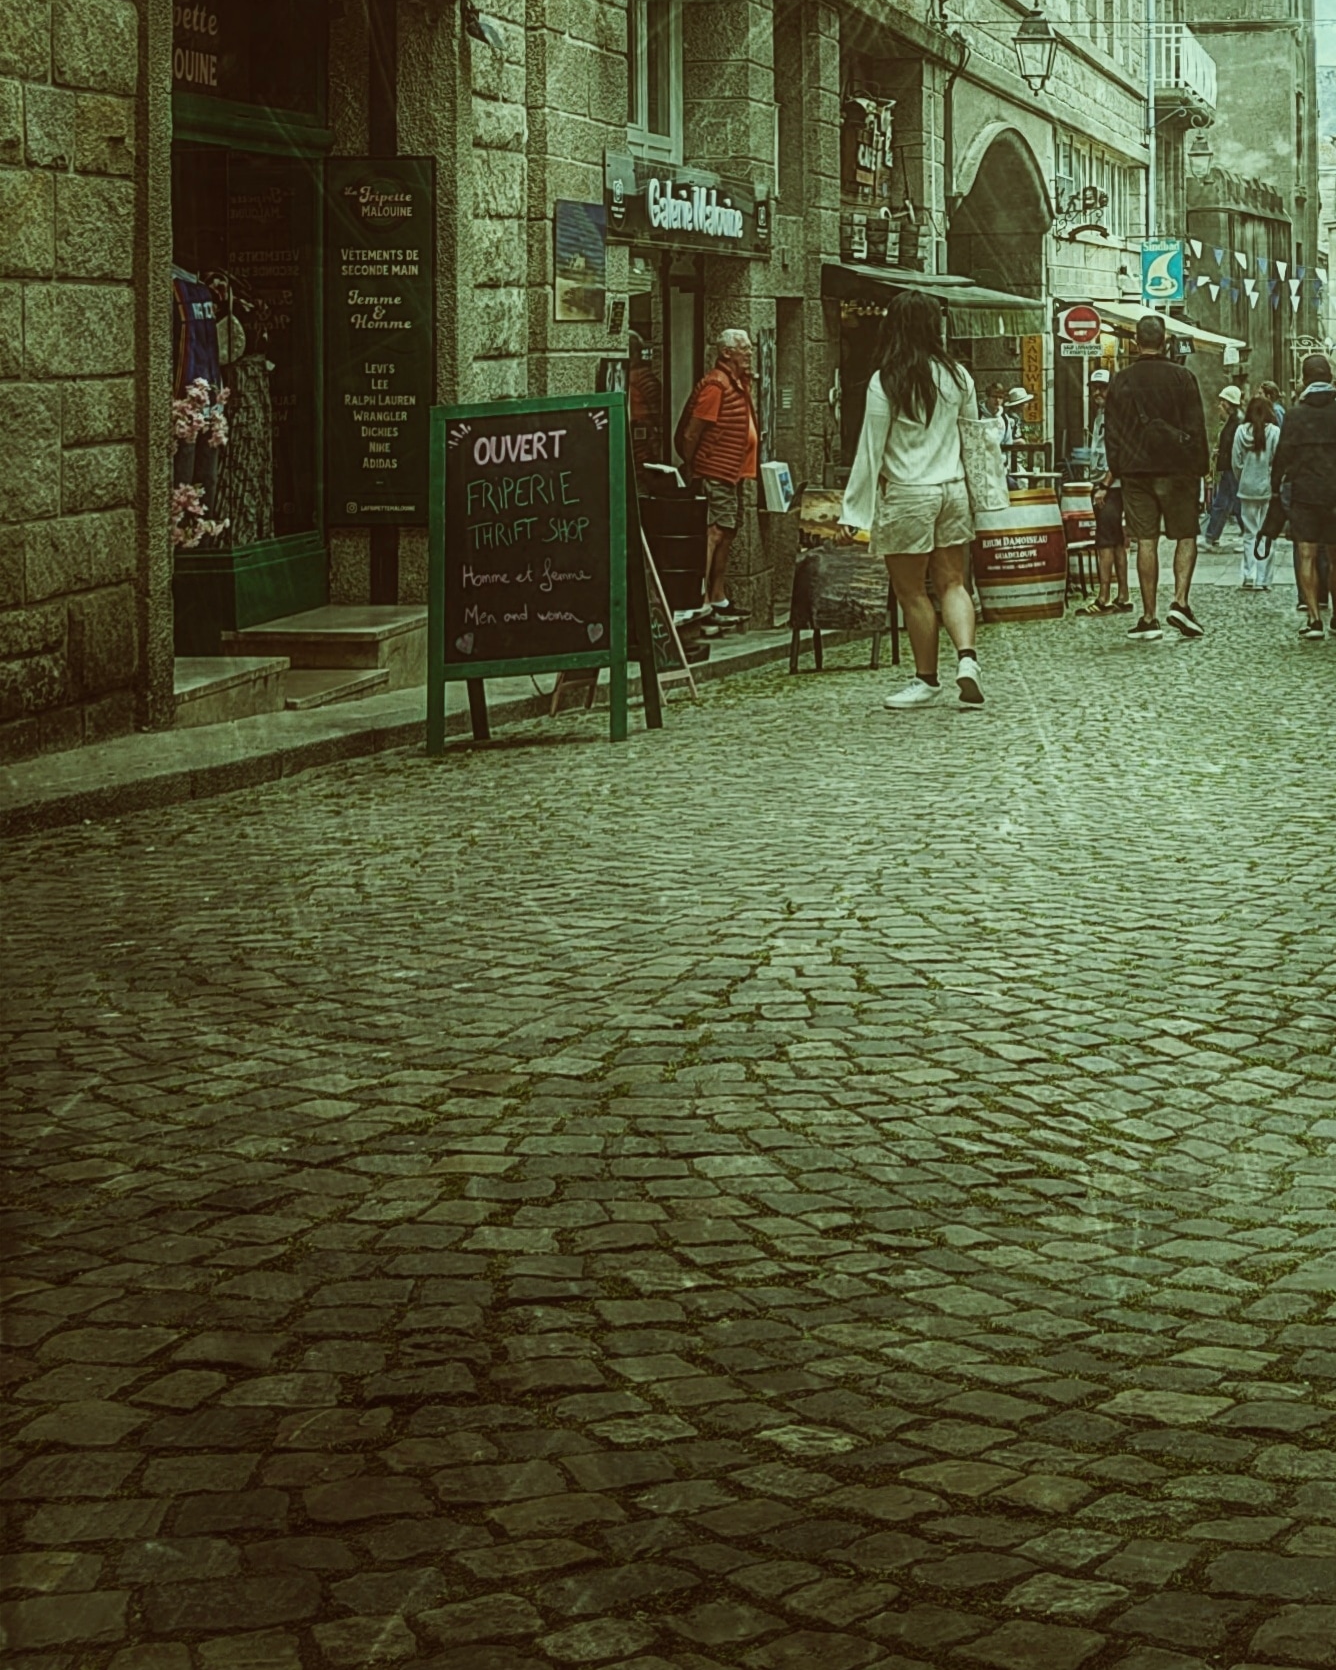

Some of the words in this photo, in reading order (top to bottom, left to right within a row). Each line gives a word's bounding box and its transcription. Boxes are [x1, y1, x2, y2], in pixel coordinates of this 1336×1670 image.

[173, 2, 219, 36] pette
[174, 47, 217, 87] OUINE
[344, 186, 357, 195] La
[359, 186, 412, 206] Fripette
[361, 206, 412, 217] MALOUINE
[650, 178, 692, 231] Galerie
[692, 186, 743, 238] Malouine
[1143, 241, 1181, 251] Sindbad
[406, 250, 419, 261] DE
[341, 265, 389, 276] SECONDE
[391, 265, 419, 276] MAIN
[348, 290, 402, 305] Femme
[373, 305, 386, 319] &
[351, 314, 412, 329] Homme
[372, 378, 389, 389] LEE
[344, 395, 376, 406] RALPH
[378, 395, 416, 406] LAUREN
[353, 411, 408, 422] WRANGLER
[361, 426, 398, 437] DICKIES
[369, 442, 391, 453] NIKE
[474, 430, 566, 465] OUVERT
[363, 457, 398, 469] ADIDAS
[467, 517, 538, 549] THRIFT
[542, 517, 589, 543] SHOP
[1003, 535, 1047, 545] DAMOISEAU
[462, 564, 510, 588] Homme
[516, 564, 533, 582] et
[540, 558, 591, 592] femme
[465, 604, 497, 626] Men
[504, 603, 528, 622] and
[537, 610, 584, 624] women
